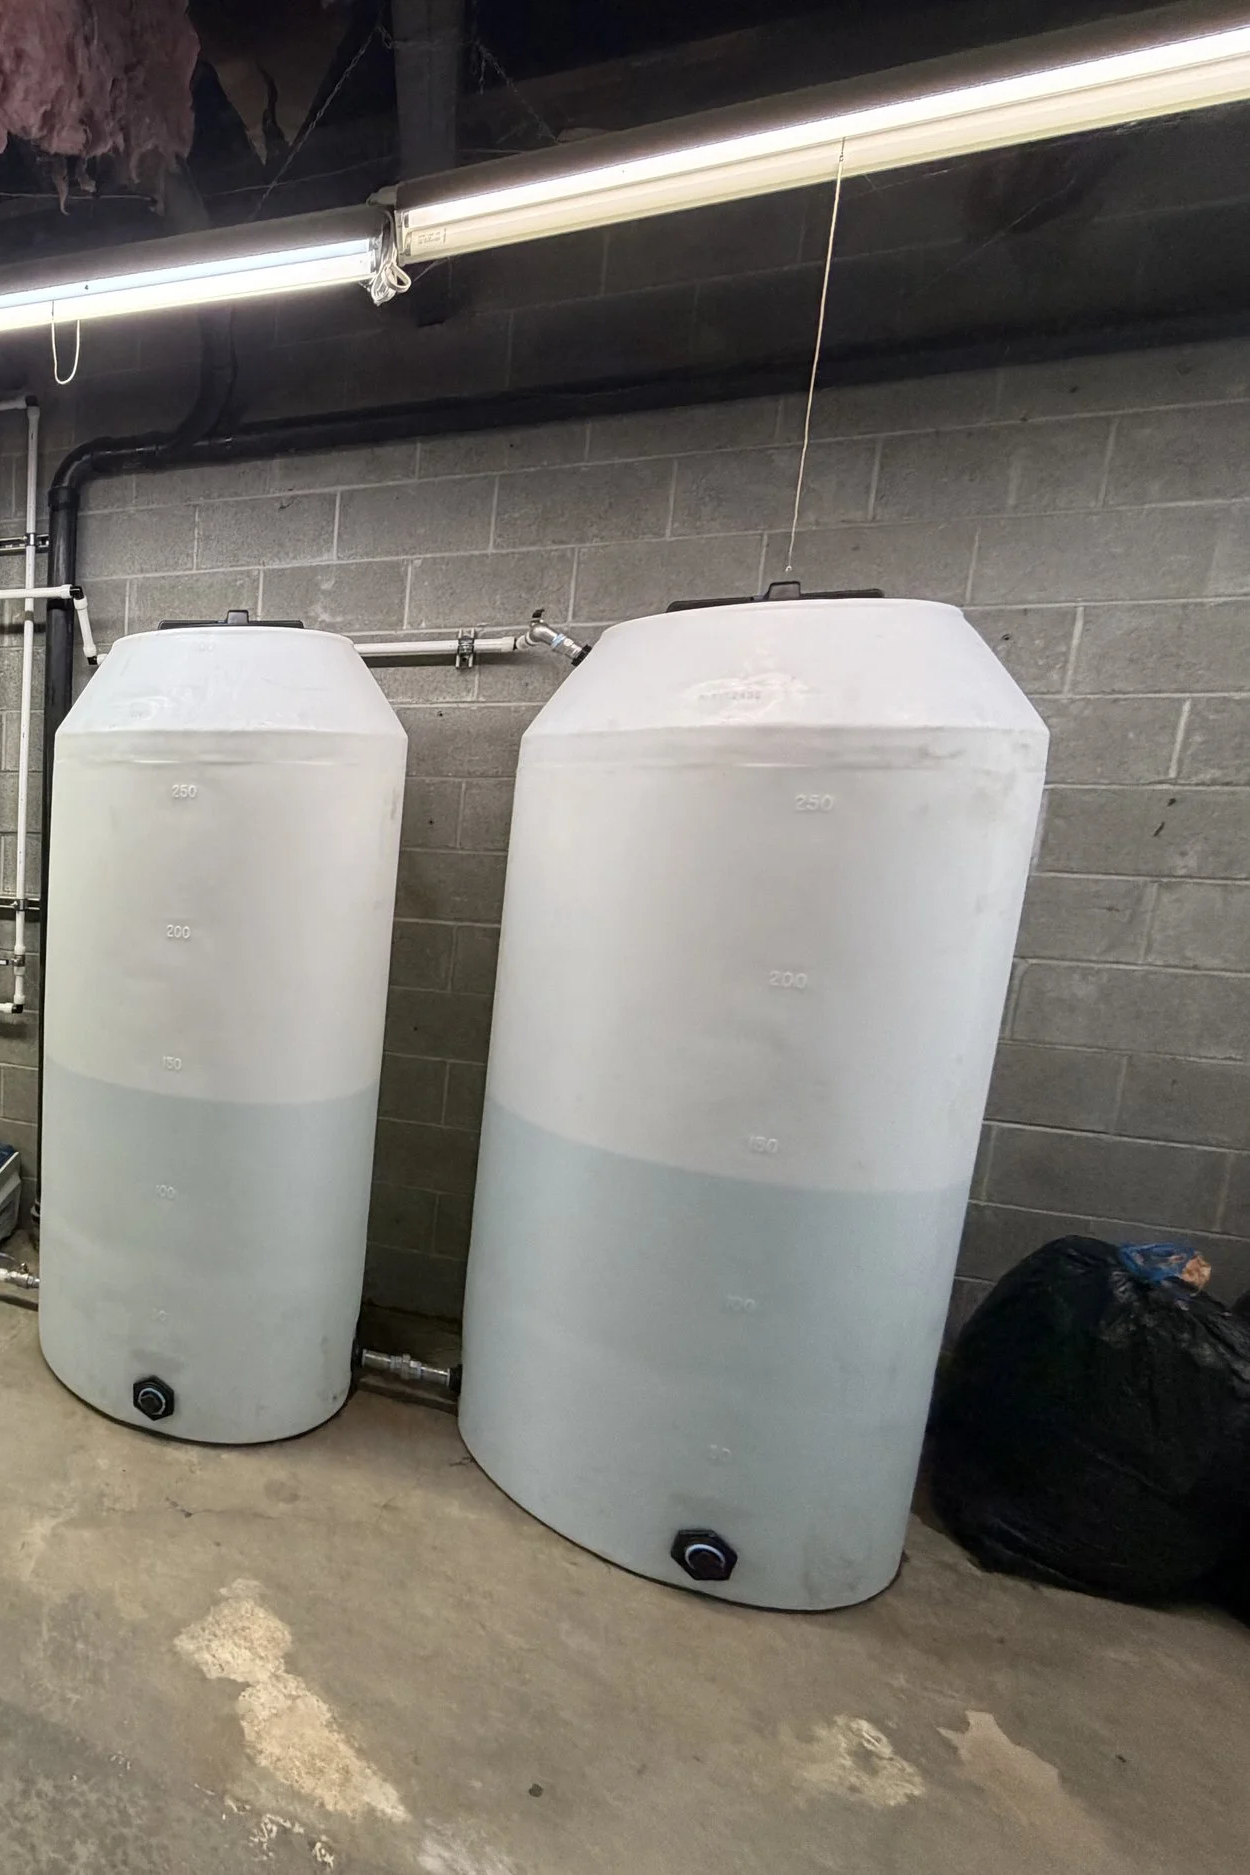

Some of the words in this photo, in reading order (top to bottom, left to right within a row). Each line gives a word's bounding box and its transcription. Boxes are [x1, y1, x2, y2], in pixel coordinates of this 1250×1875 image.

[172, 784, 197, 798] 250
[795, 794, 834, 812] 250
[166, 924, 190, 939] 200
[769, 970, 808, 988] 200
